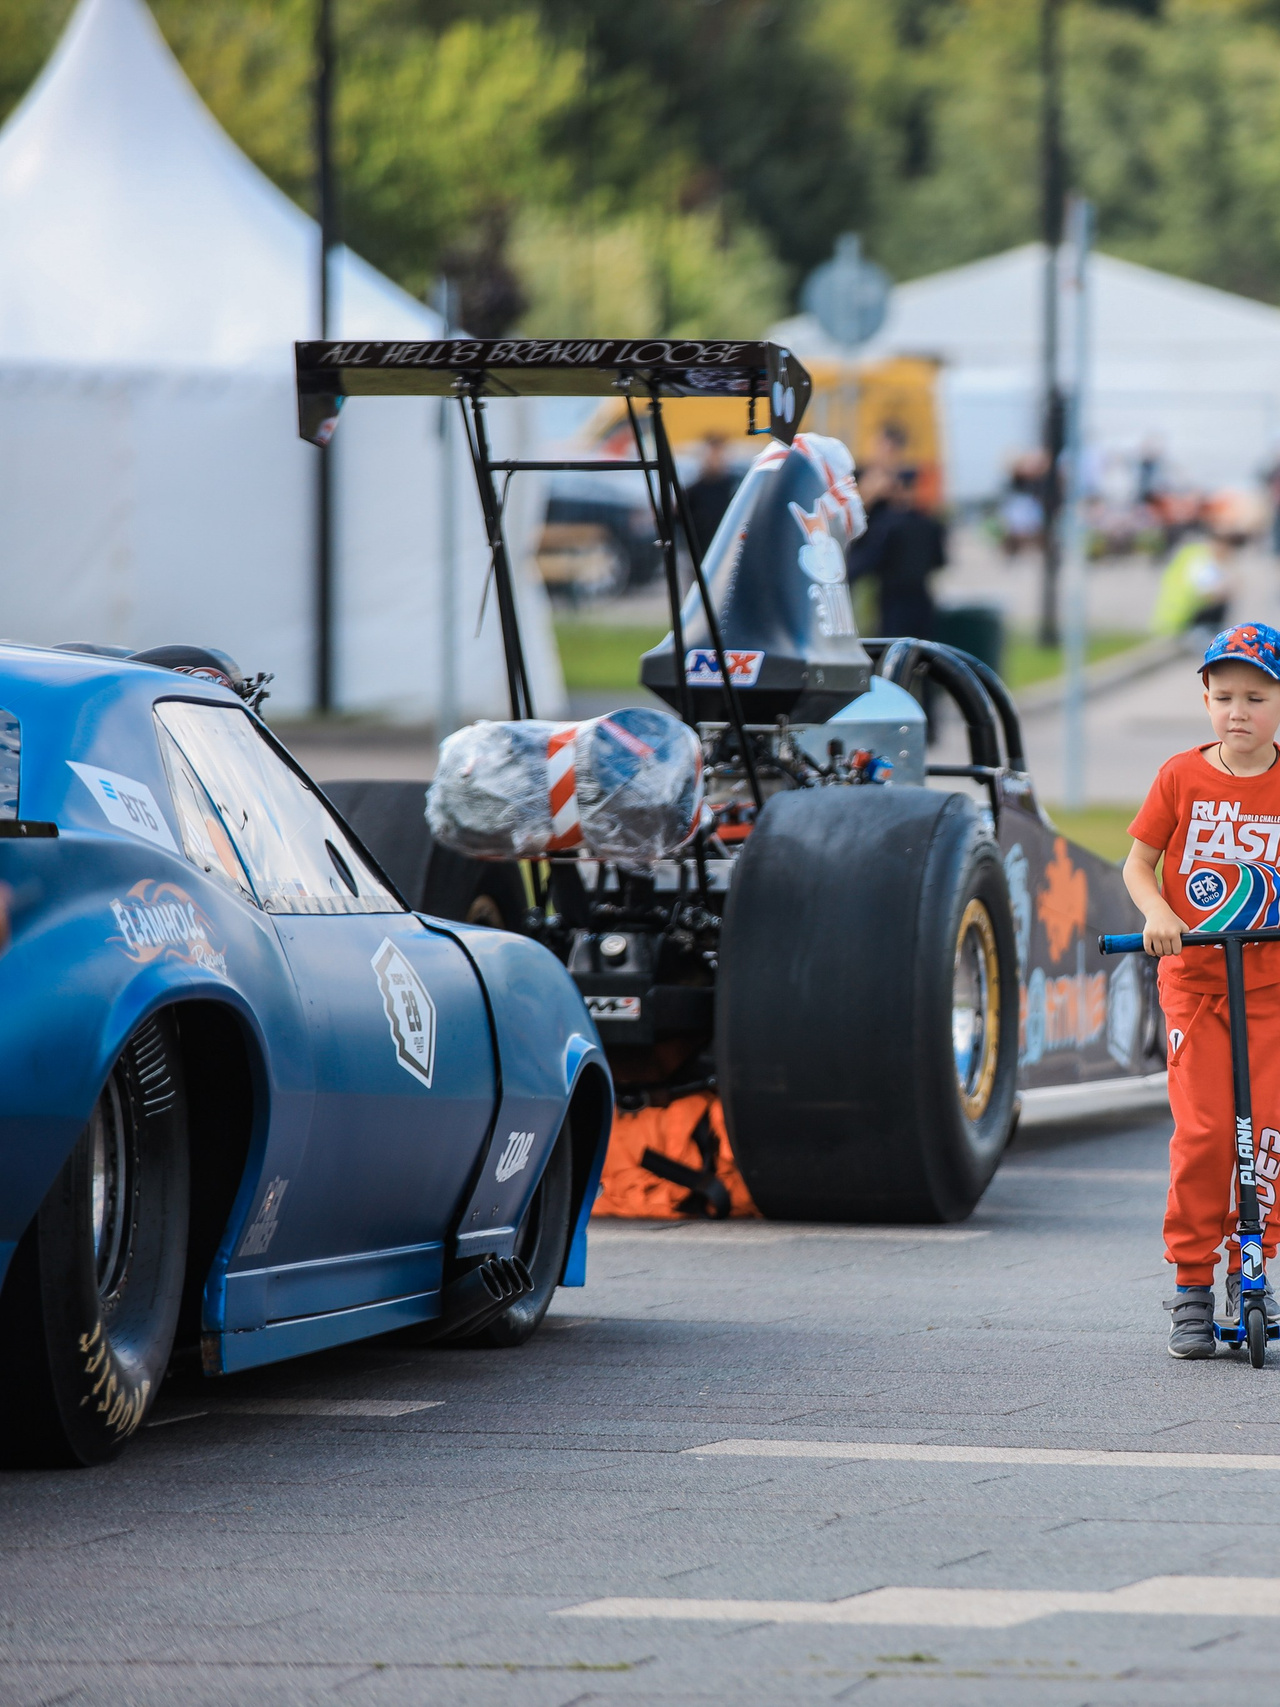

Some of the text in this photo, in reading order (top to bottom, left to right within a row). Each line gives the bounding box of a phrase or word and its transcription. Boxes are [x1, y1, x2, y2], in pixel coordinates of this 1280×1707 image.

[319, 342, 372, 364] ALL
[613, 341, 751, 364] LOOSE
[117, 790, 159, 832] ВТБ
[1191, 800, 1241, 822] RUN
[1238, 814, 1259, 823] WORLD
[1190, 875, 1219, 900] 日本
[400, 990, 423, 1033] 28
[1236, 1115, 1256, 1187] PLANK
